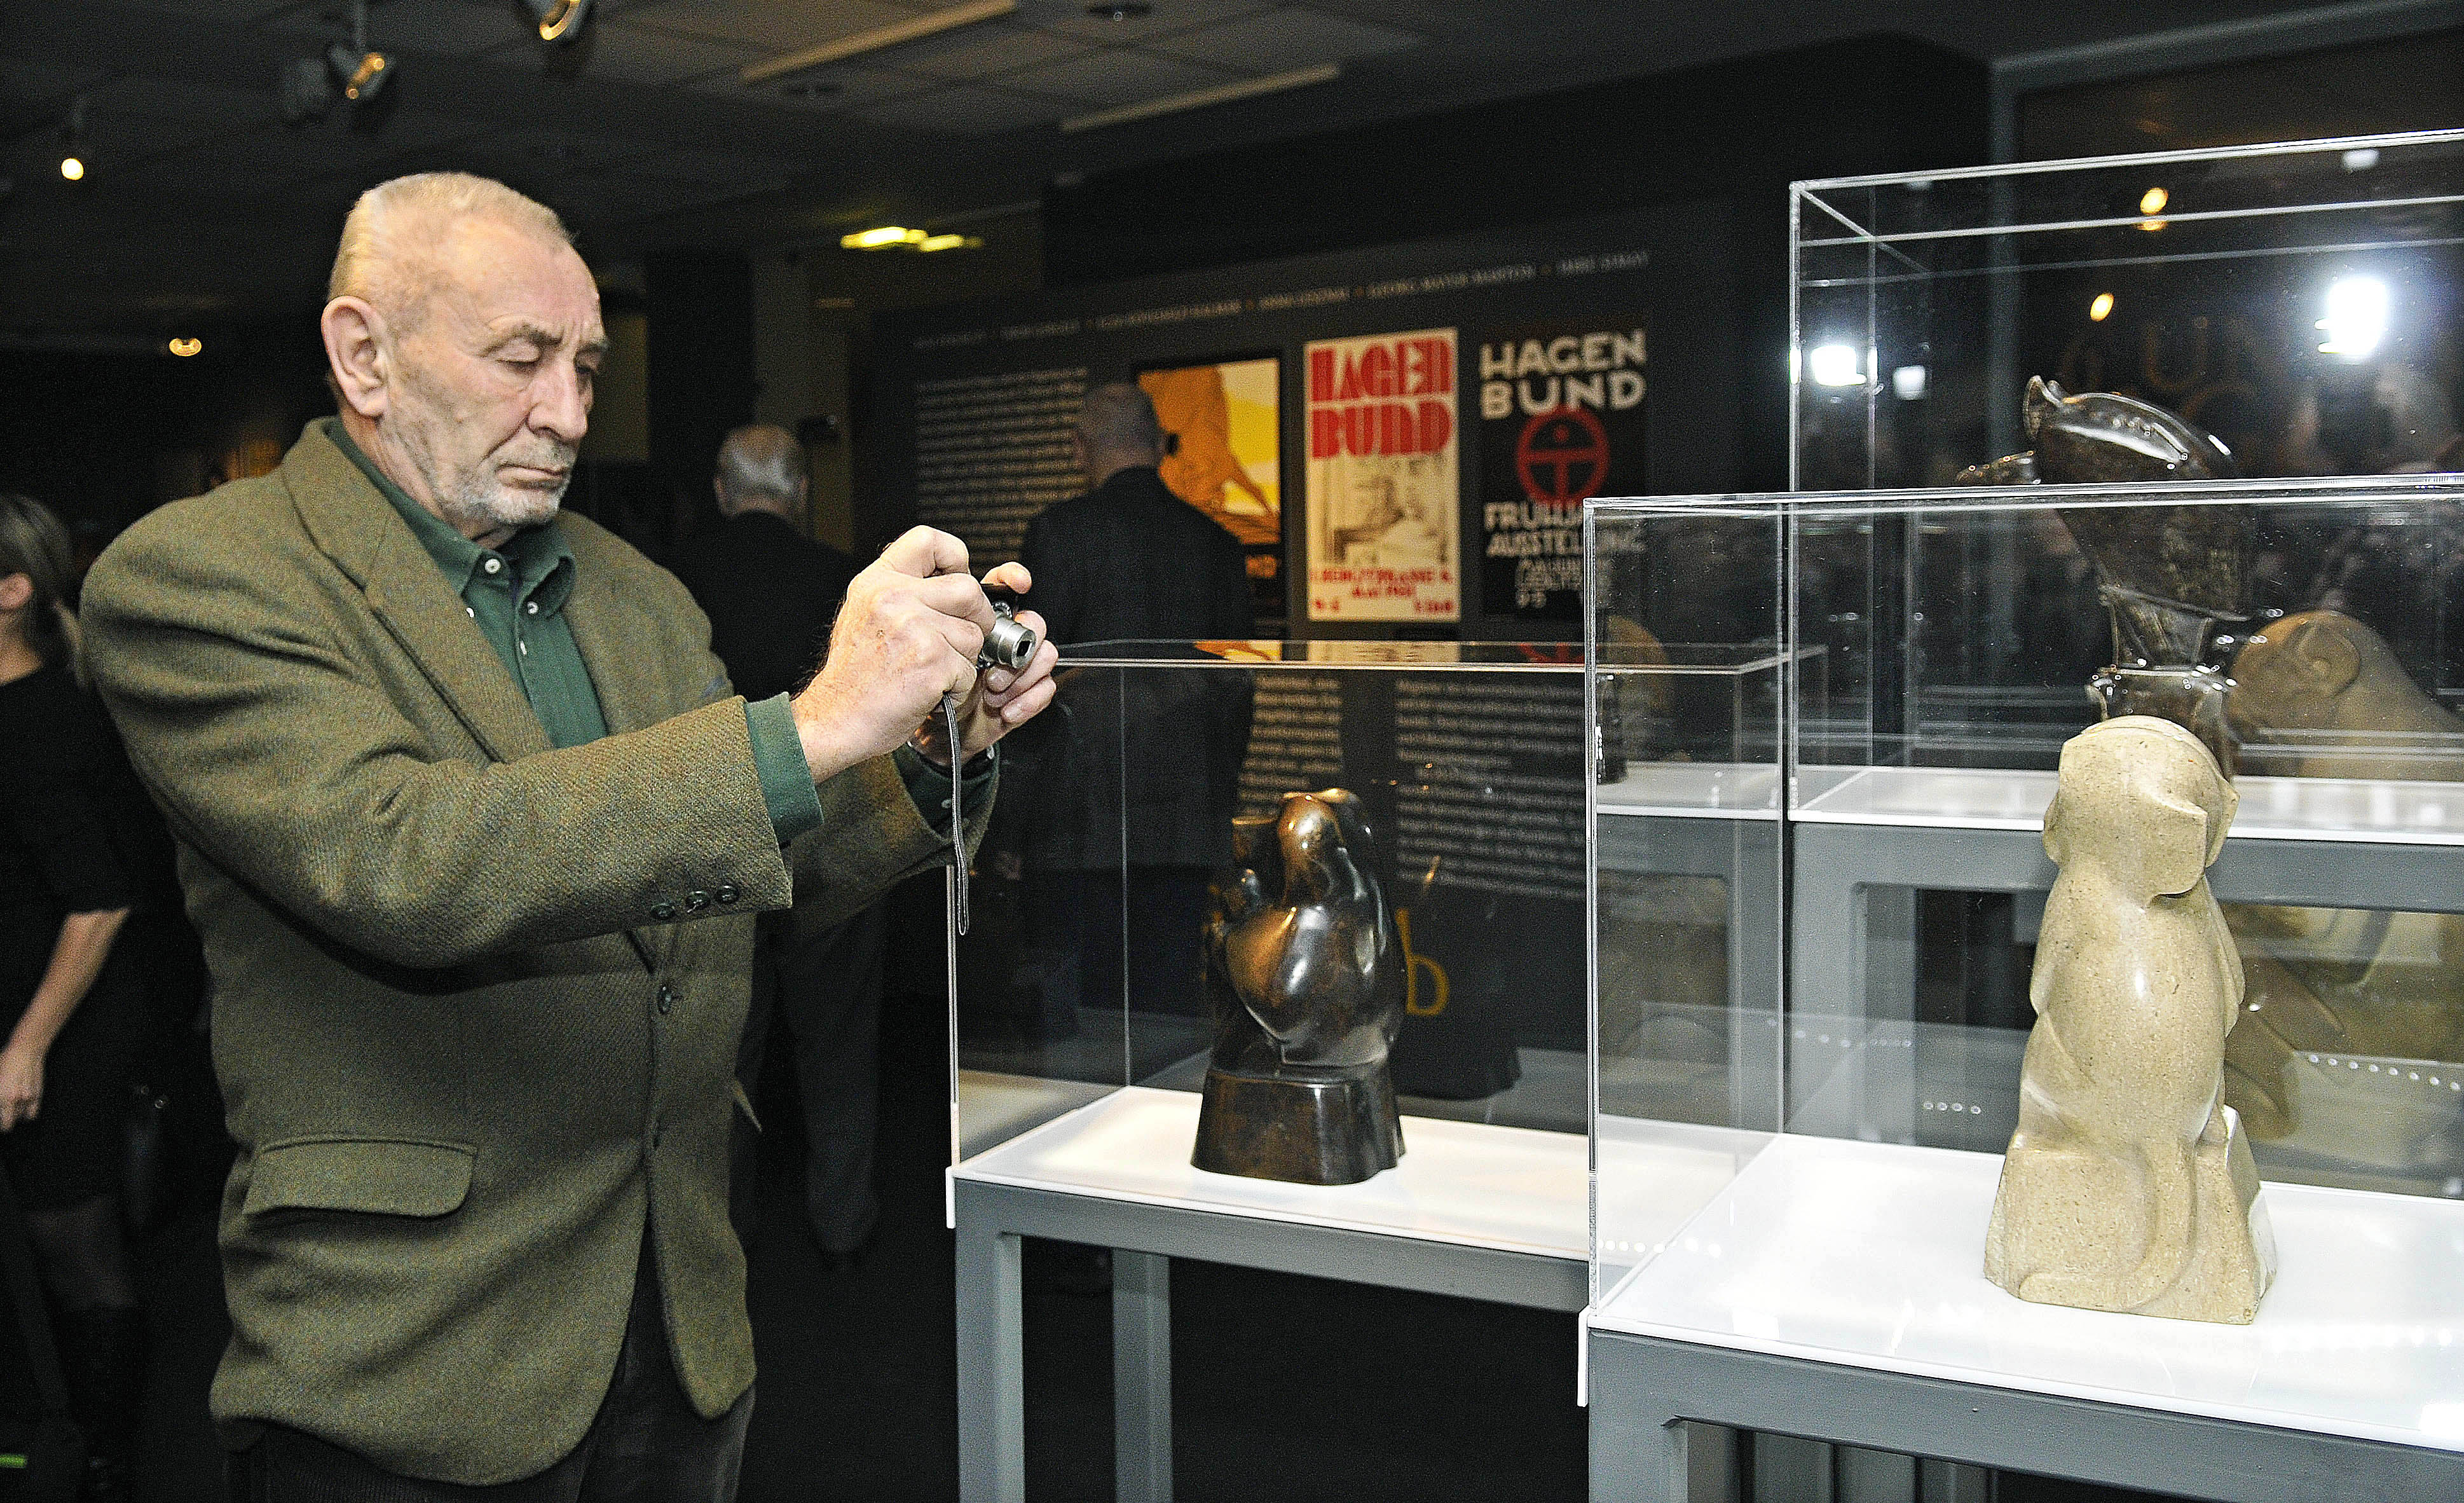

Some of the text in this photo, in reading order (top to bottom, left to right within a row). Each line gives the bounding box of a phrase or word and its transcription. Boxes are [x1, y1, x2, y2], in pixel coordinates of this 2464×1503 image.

[1311, 338, 1451, 402] HAGEN
[1479, 327, 1648, 381] HAGEN
[1480, 369, 1646, 420] BUND
[1312, 401, 1452, 458] BUND
